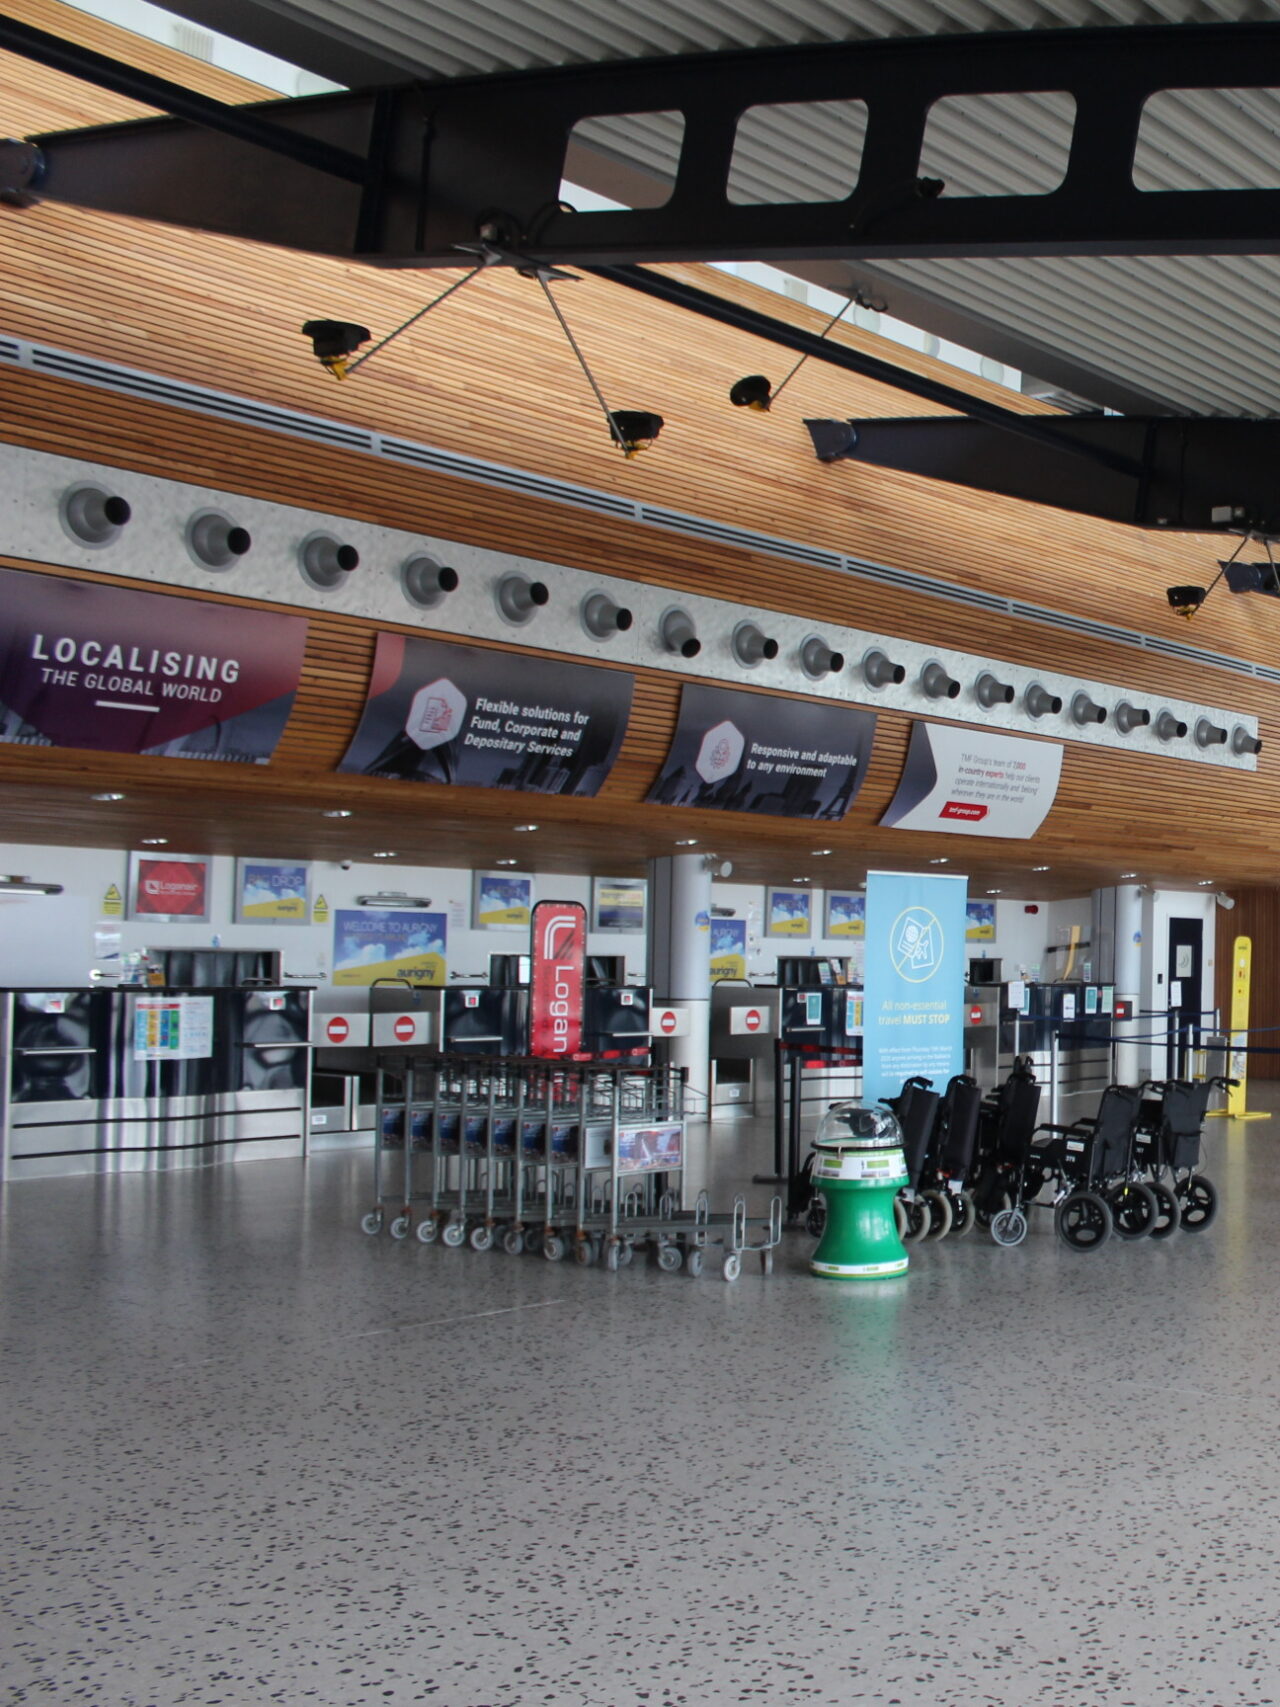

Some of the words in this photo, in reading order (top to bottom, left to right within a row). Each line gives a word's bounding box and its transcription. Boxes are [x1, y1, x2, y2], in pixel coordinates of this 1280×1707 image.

[32, 634, 240, 684] LOCALISING
[42, 668, 79, 687] THE
[84, 673, 154, 696] GLOBAL
[162, 683, 222, 703] WORLD
[475, 698, 519, 716] Flexible
[521, 706, 571, 723] solutions
[573, 711, 590, 725] for
[470, 716, 501, 734] Fund,
[505, 721, 559, 739] Corporate
[560, 729, 583, 742] and
[464, 733, 526, 754] Depositary
[527, 741, 574, 758] Services
[750, 743, 800, 759] Responsive
[801, 750, 818, 761] and
[818, 752, 857, 767] adaptable
[961, 753, 973, 761] TMF
[746, 759, 757, 769] to
[757, 762, 774, 774] any
[775, 763, 828, 778] environment
[985, 770, 1004, 779] experts
[271, 875, 303, 887] DROP
[343, 921, 386, 932] WELCOME
[387, 922, 400, 933] TO
[396, 966, 435, 981] aurigny
[881, 1000, 893, 1010] All
[895, 1000, 947, 1010] non-essential
[878, 1014, 901, 1025] travel
[903, 1014, 927, 1025] MUST
[927, 1013, 951, 1025] STOP
